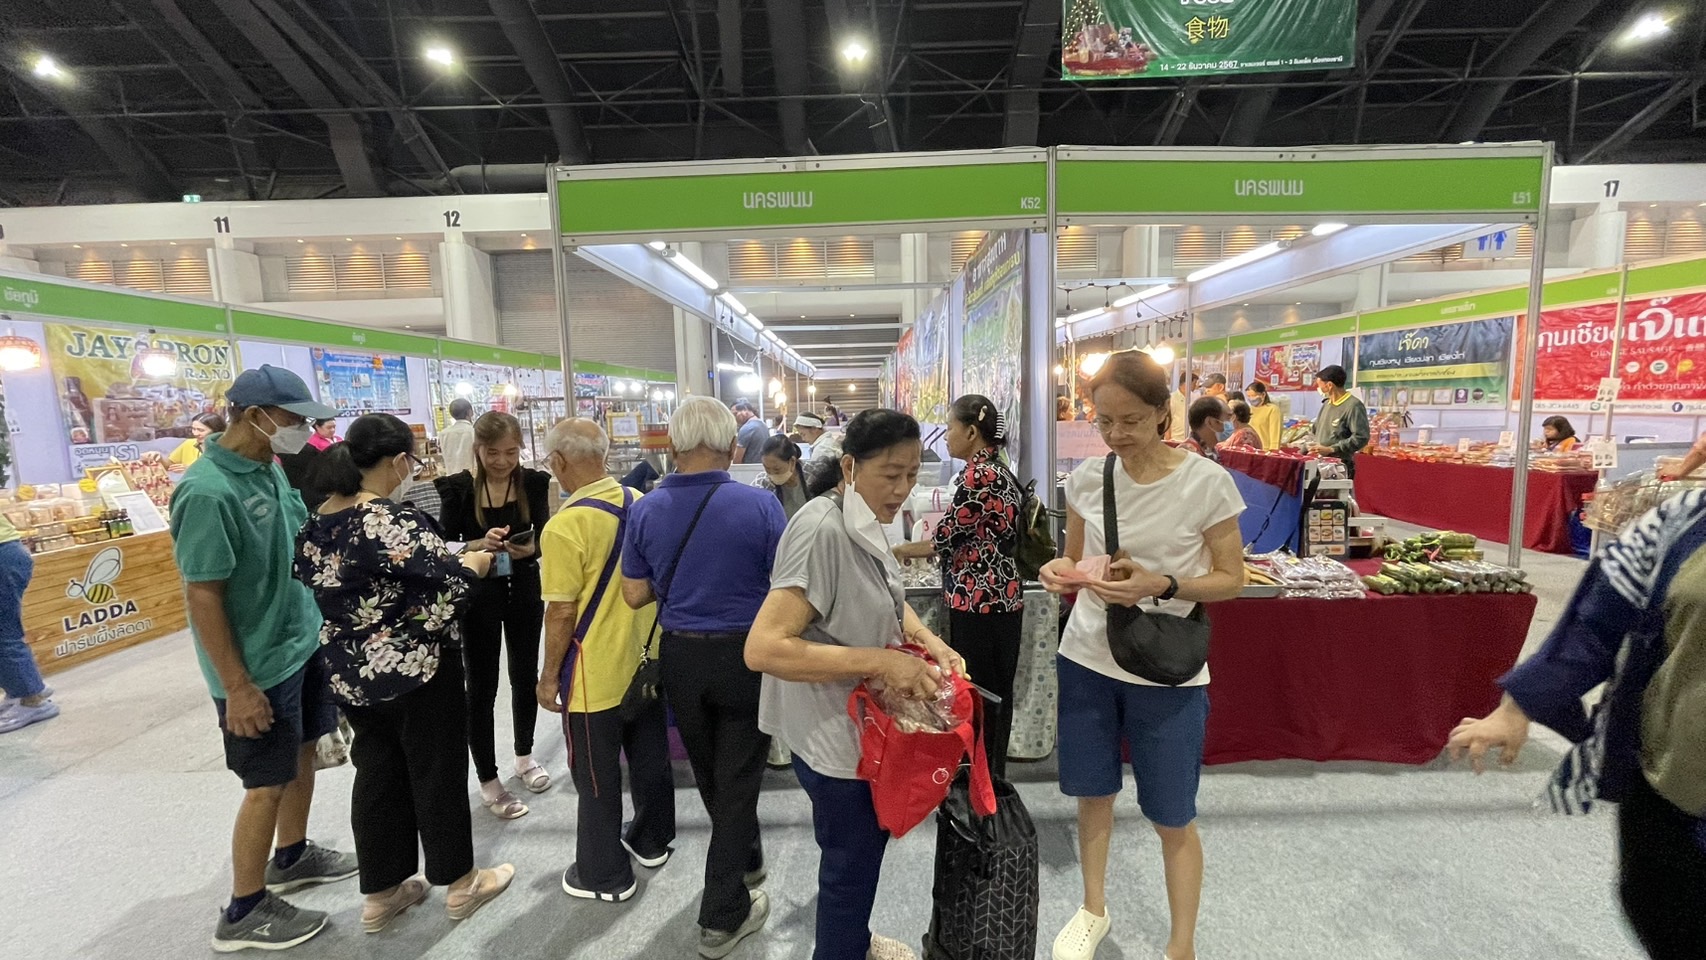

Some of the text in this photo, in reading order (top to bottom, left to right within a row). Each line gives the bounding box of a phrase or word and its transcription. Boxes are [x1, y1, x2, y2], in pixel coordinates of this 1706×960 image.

[1185, 16, 1230, 42] 食物
[1160, 63, 1169, 71] 14
[1177, 63, 1187, 71] 22
[1234, 179, 1304, 196] นครพนม
[1603, 179, 1620, 198] 17
[743, 191, 813, 208] นครพนม
[1020, 197, 1041, 209] K52
[1512, 192, 1531, 204] L51
[213, 216, 230, 234] 11
[443, 210, 461, 227] 12
[66, 333, 132, 358] JAY
[64, 600, 138, 632] LADDA
[55, 618, 153, 657] ฟาร์มผึ้งลัดดา
